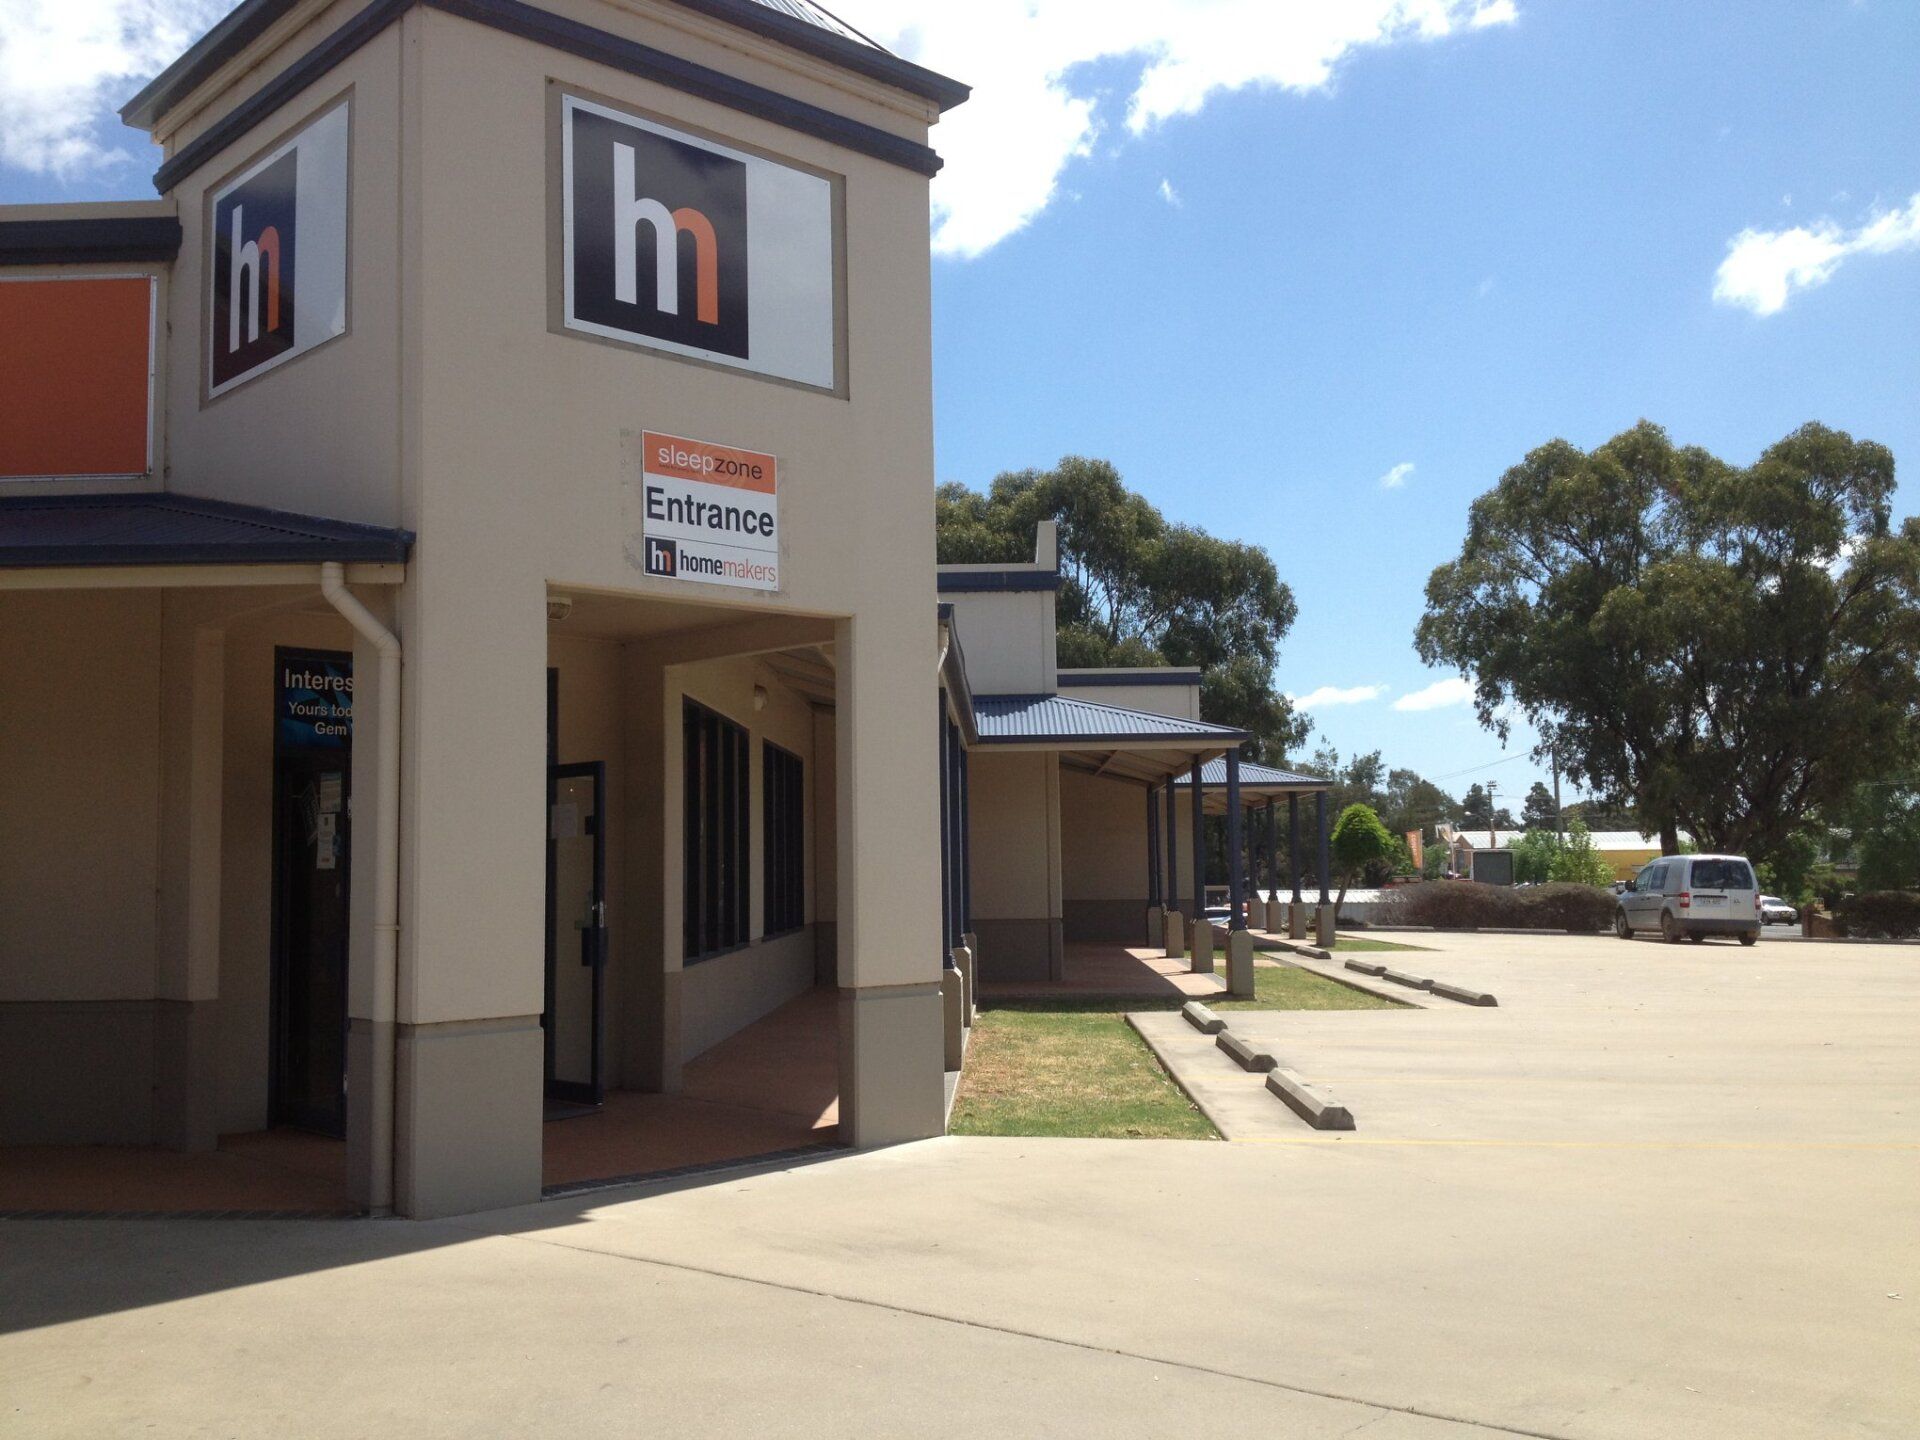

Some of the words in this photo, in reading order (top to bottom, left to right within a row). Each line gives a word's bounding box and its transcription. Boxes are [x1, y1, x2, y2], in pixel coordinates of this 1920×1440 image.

[658, 445, 762, 480] sleepzone
[646, 486, 774, 537] Entrance
[680, 550, 776, 582] homemakers
[288, 701, 328, 716] Yours
[315, 721, 347, 736] Gem
